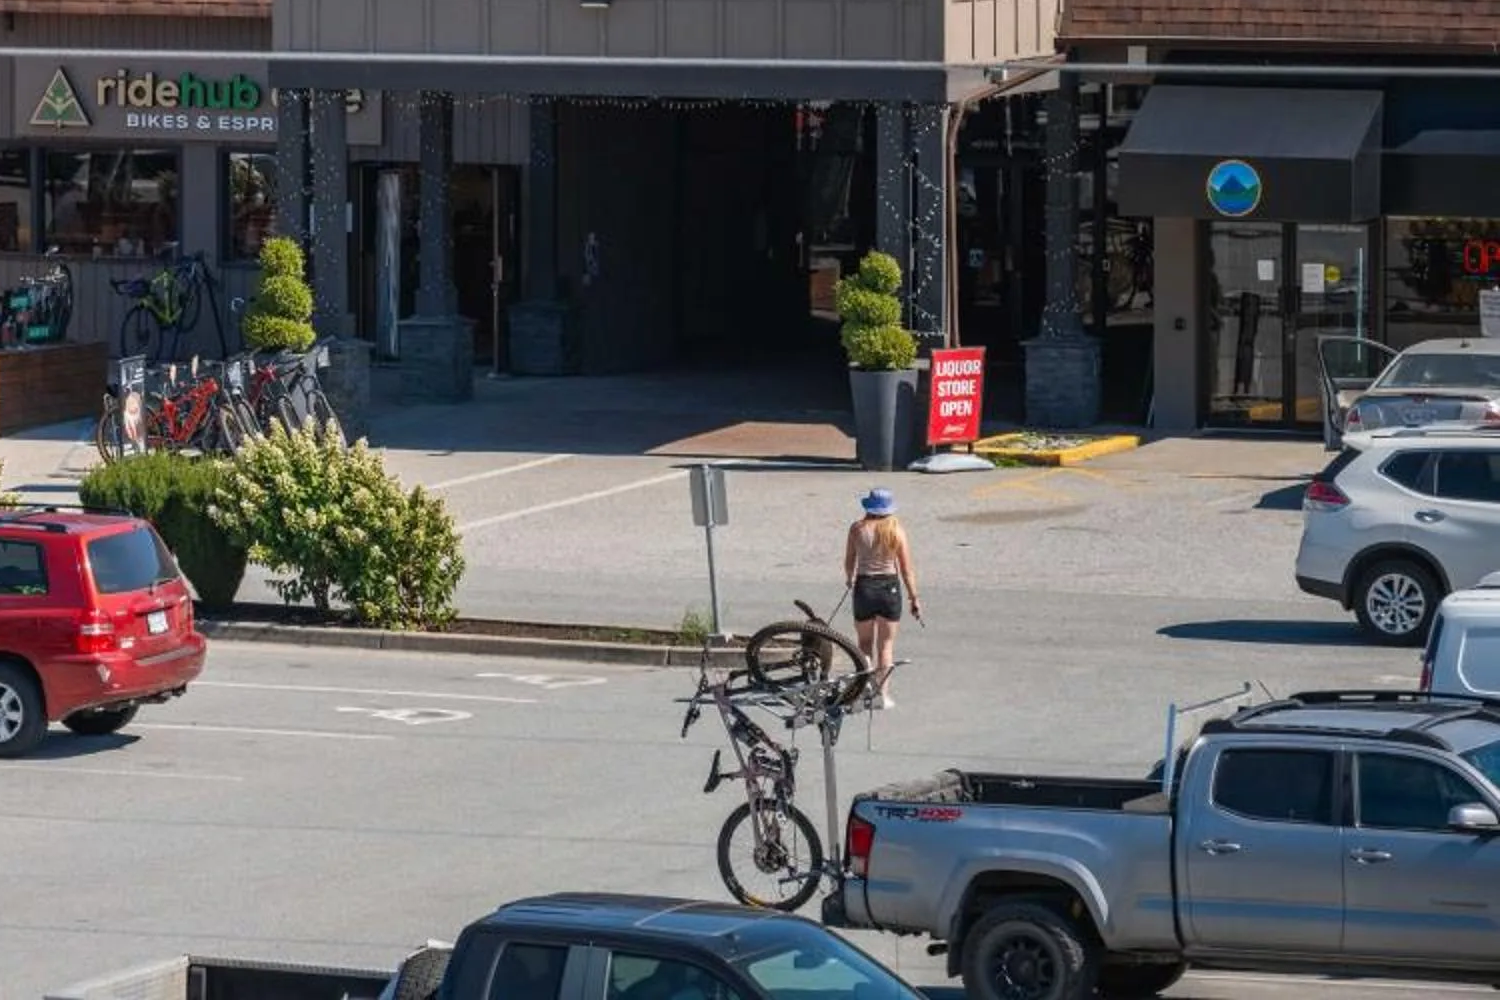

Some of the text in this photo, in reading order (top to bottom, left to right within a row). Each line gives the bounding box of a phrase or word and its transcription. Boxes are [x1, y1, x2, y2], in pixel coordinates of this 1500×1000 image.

[96, 69, 261, 111] ridehub
[127, 113, 277, 132] BIKES & ESPR
[936, 360, 981, 377] LIQUOR
[938, 379, 977, 397] STORE
[940, 399, 973, 417] OPEN
